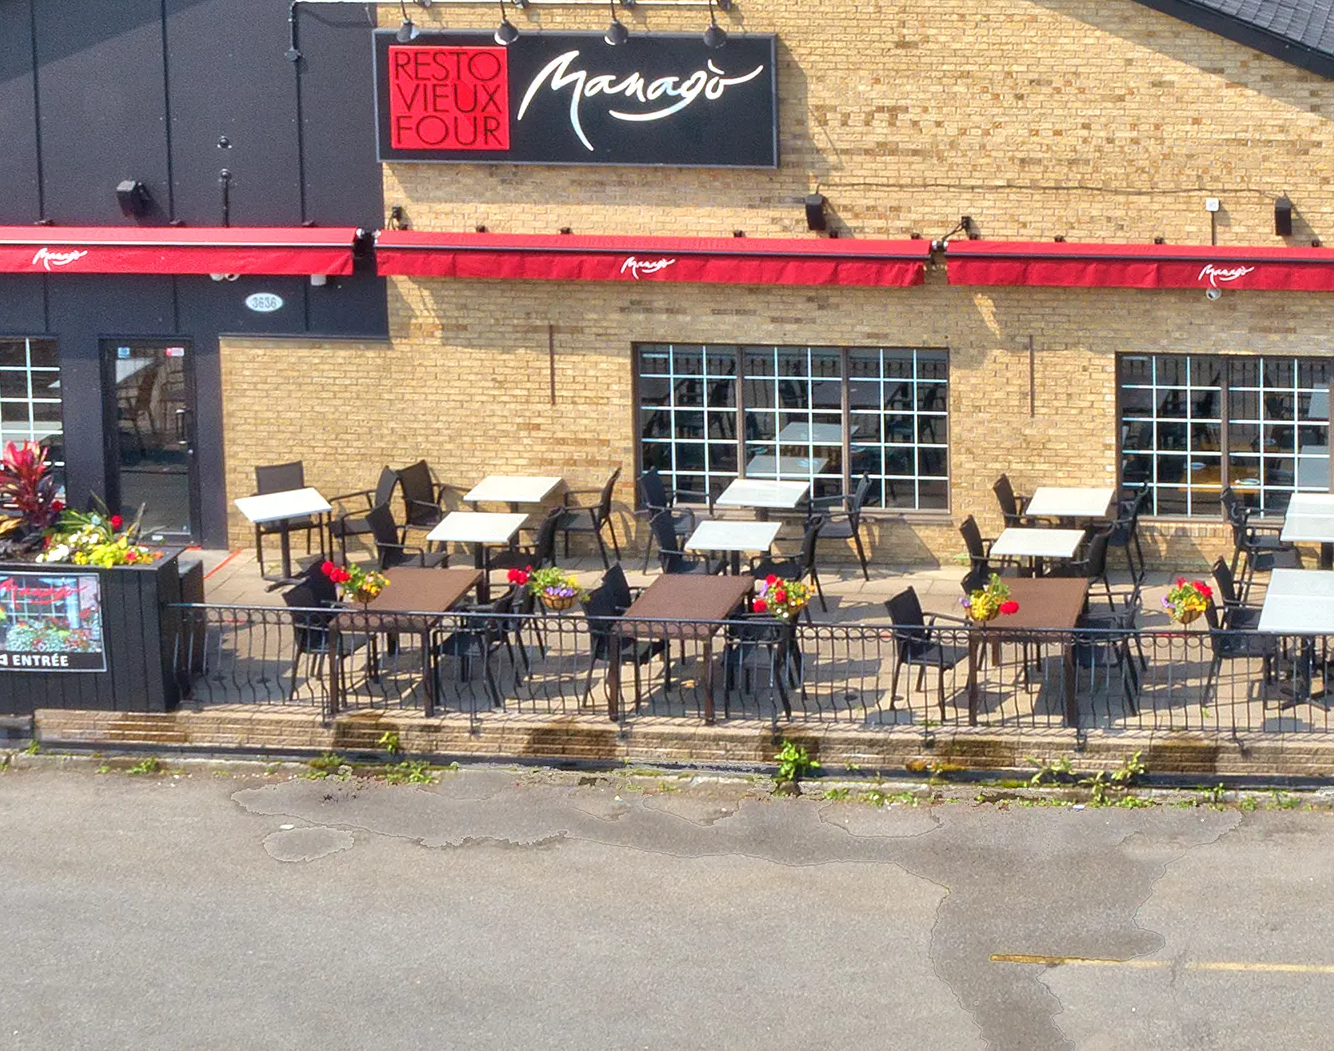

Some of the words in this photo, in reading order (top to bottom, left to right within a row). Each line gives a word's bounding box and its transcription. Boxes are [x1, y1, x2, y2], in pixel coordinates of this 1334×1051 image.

[394, 51, 501, 81] RESTO
[395, 83, 501, 113] VIEUX
[396, 115, 505, 147] FOUR
[252, 296, 277, 309] 3636
[12, 653, 69, 667] ENTRÉE
